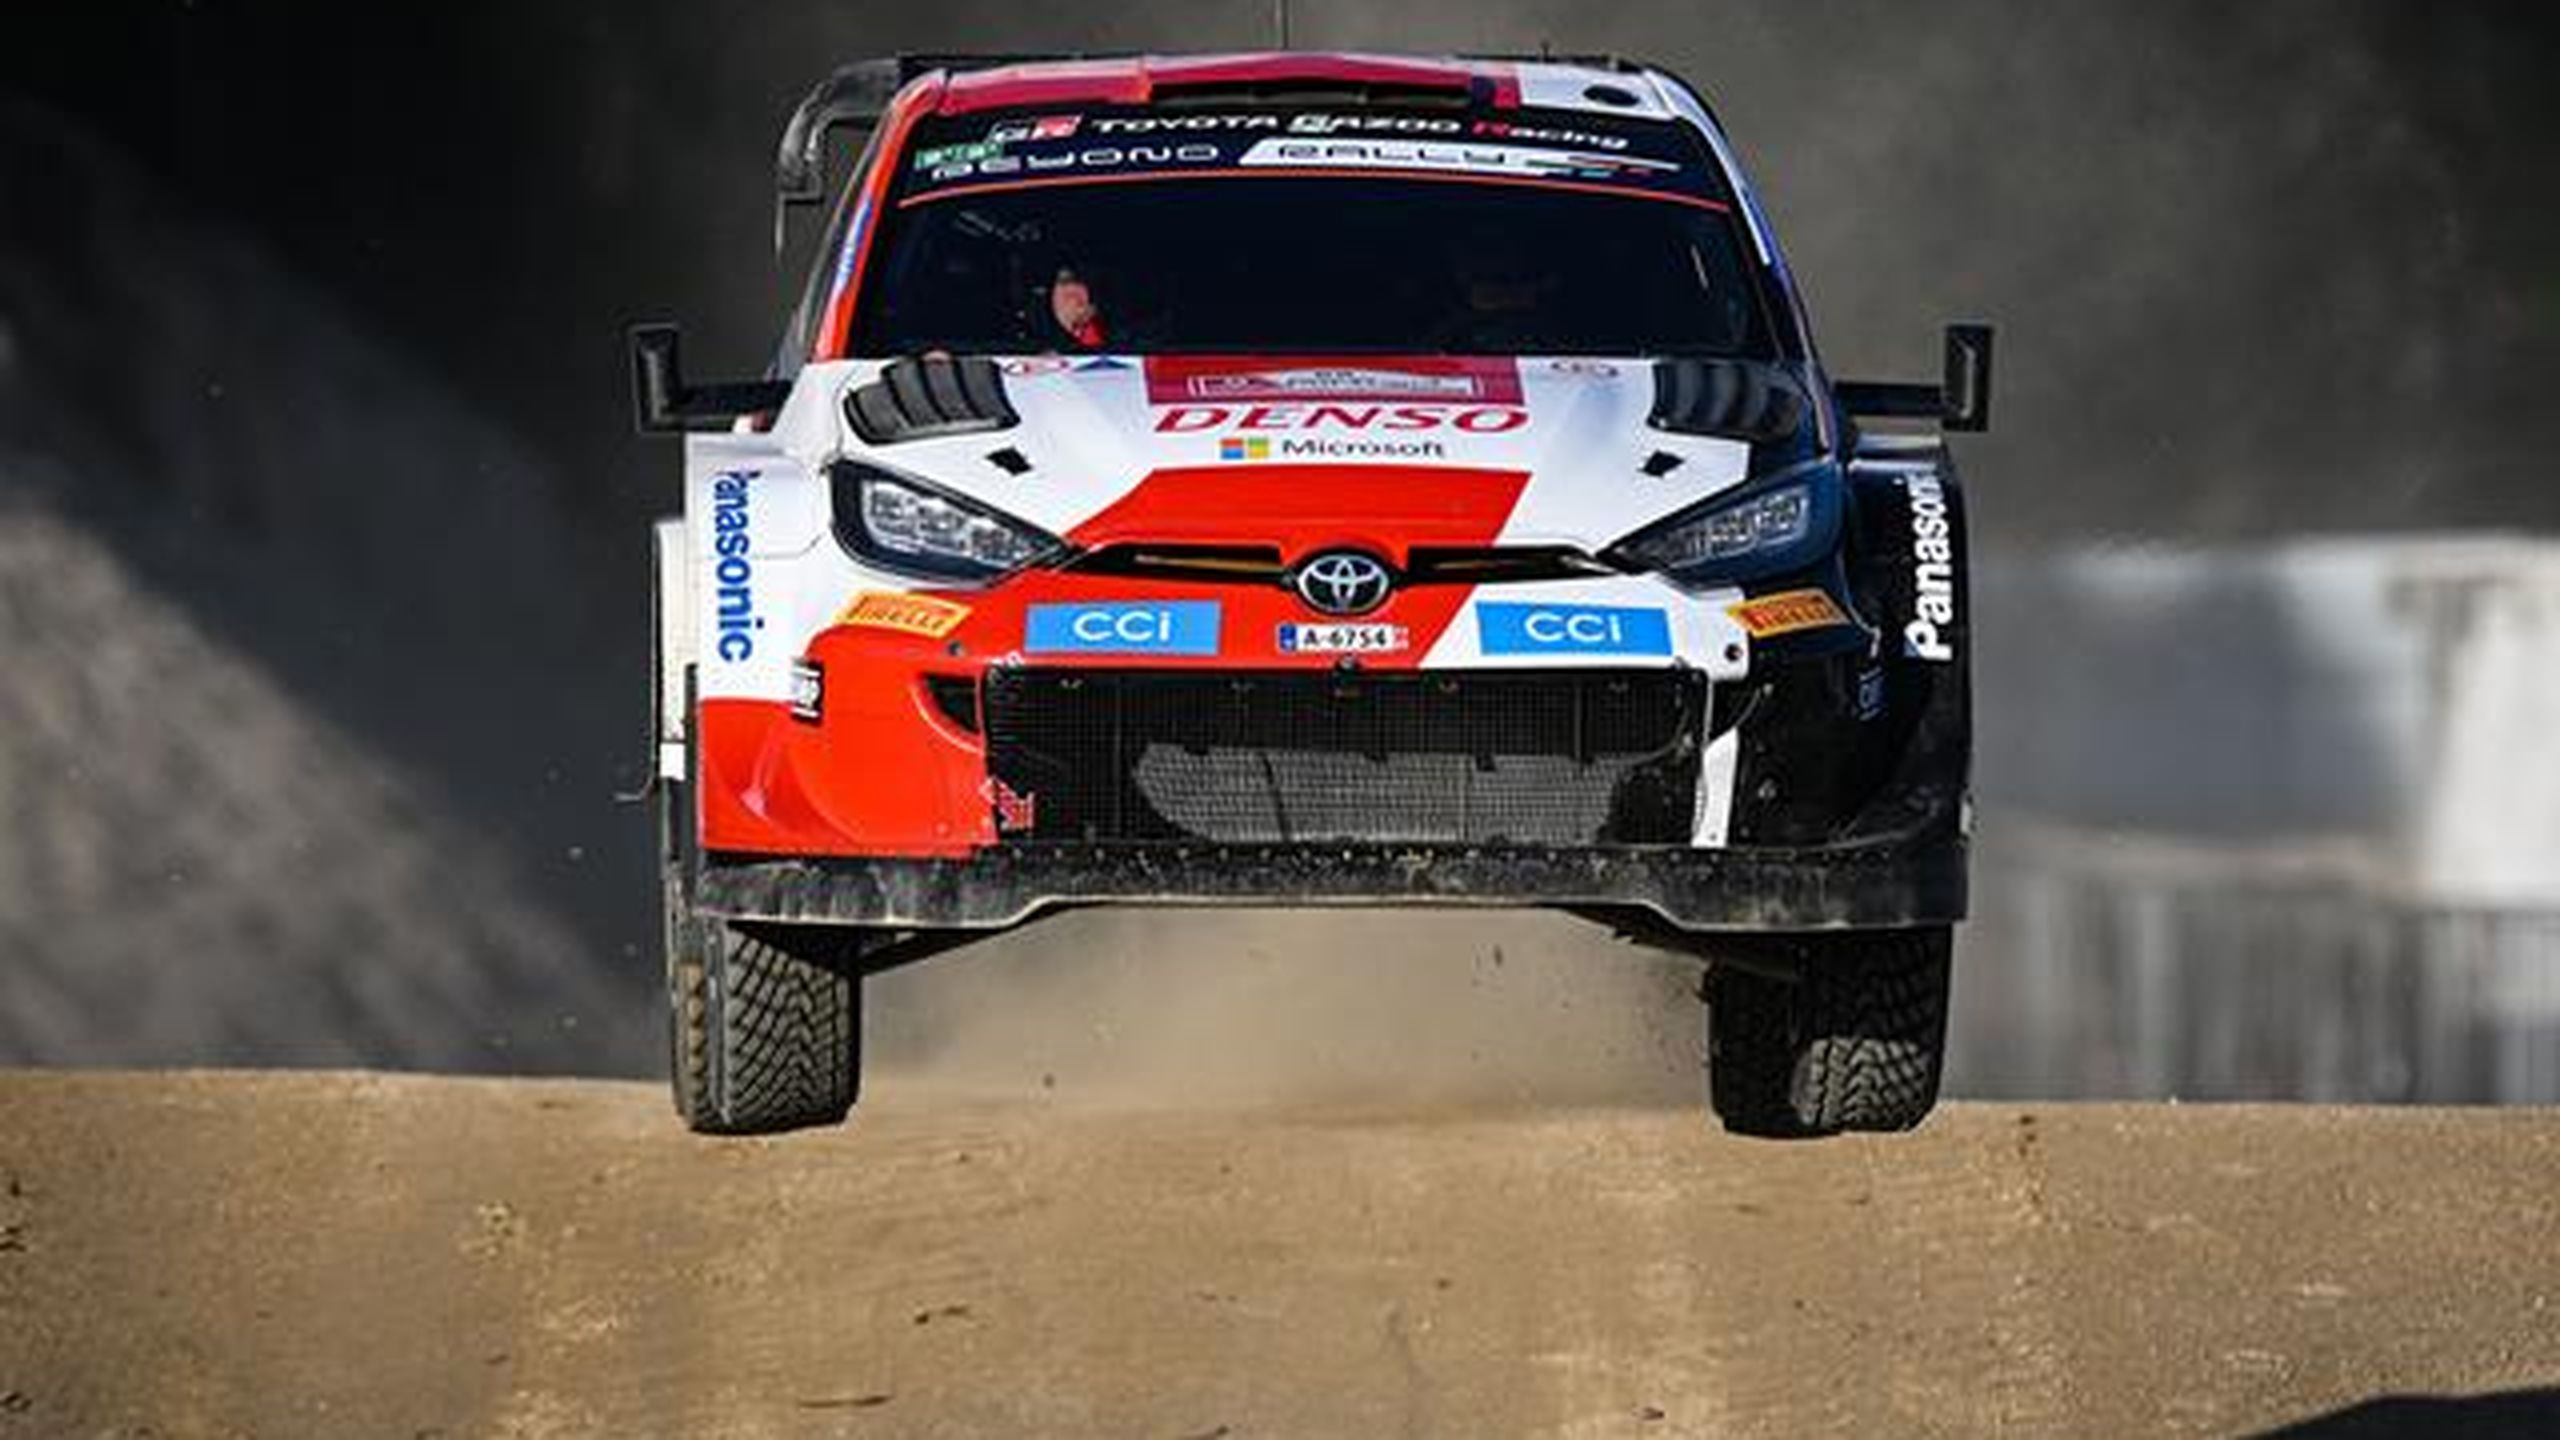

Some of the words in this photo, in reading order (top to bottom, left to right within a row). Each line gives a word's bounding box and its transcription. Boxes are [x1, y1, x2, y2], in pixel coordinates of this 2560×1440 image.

[1092, 115, 1278, 132] TOYOTA
[1287, 114, 1461, 133] GAZOO
[1471, 121, 1628, 149] Racing
[1278, 144, 1506, 166] RALLY
[1155, 407, 1530, 434] DENSO
[1281, 436, 1446, 460] Microsoft
